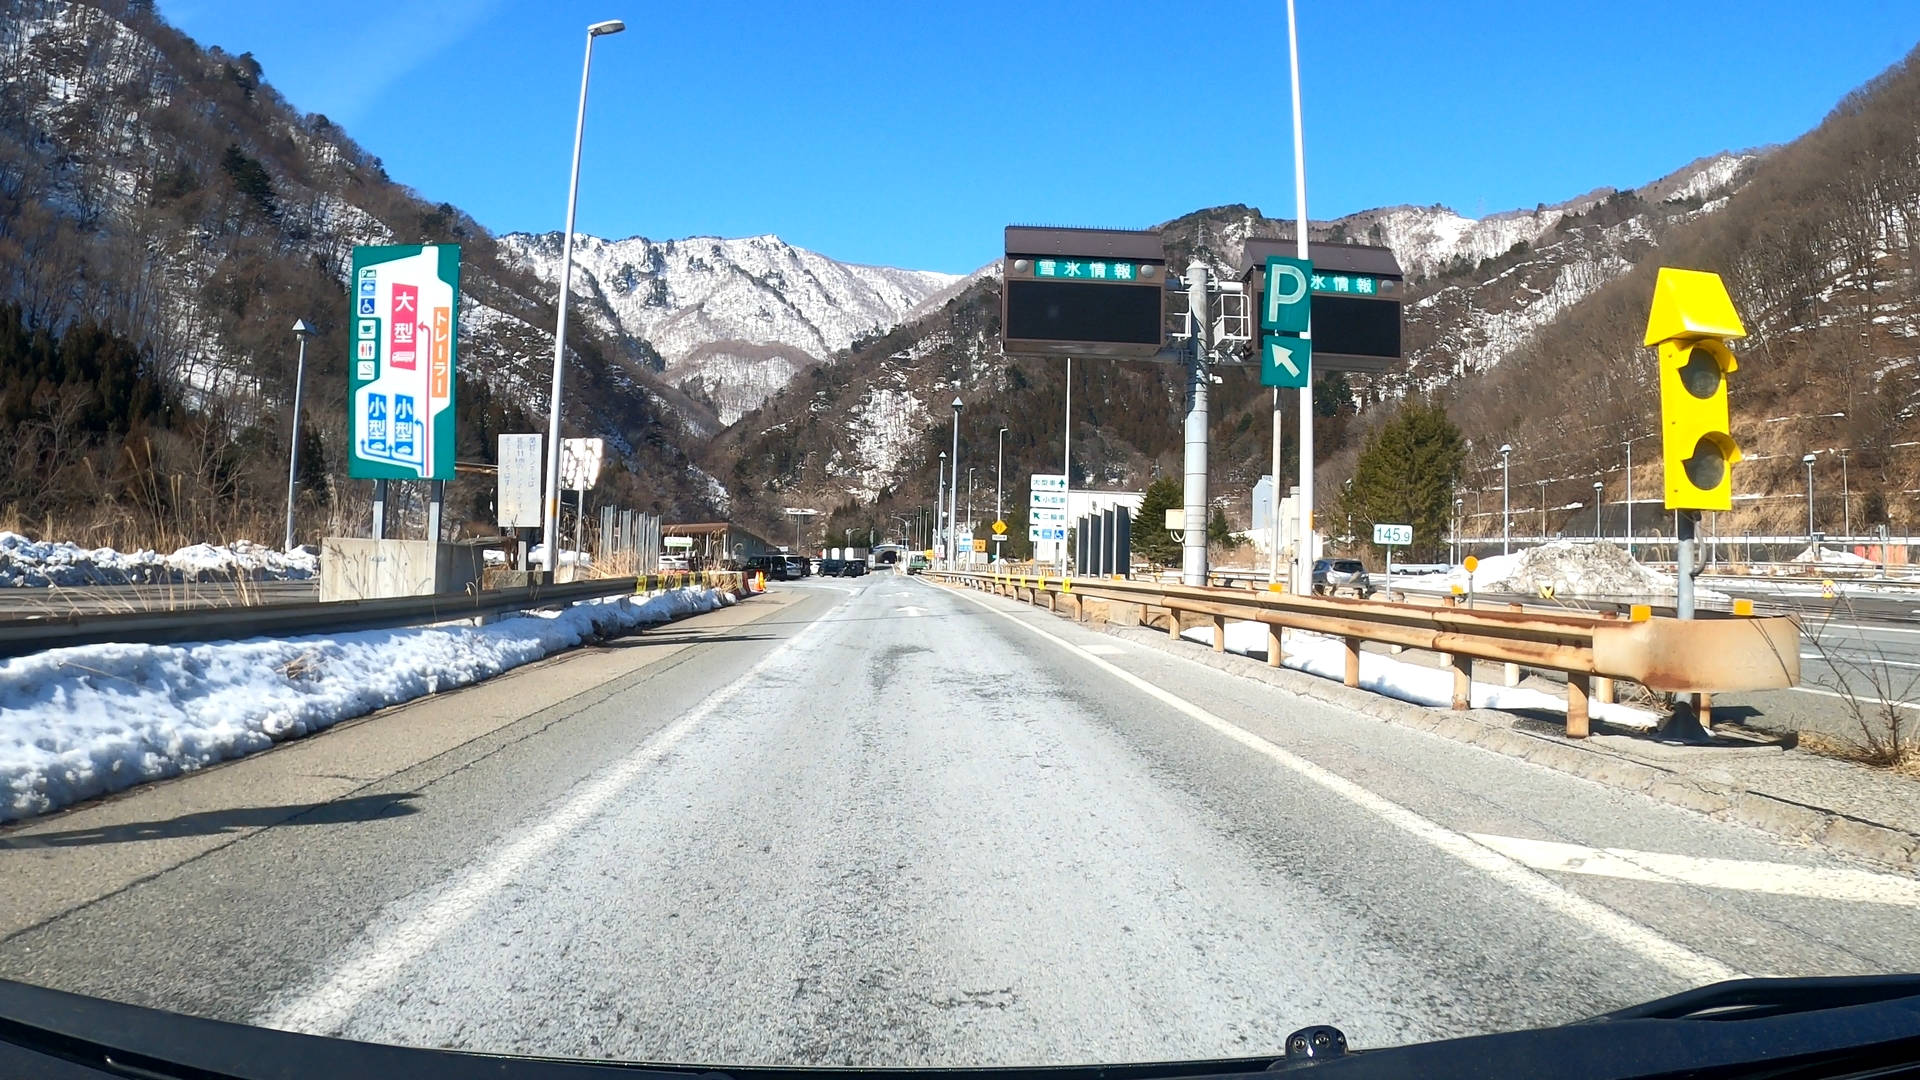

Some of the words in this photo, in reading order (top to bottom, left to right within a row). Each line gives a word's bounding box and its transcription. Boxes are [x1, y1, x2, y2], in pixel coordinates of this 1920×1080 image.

[1039, 260, 1132, 280] 雪氷情報
[1268, 263, 1307, 323] P
[394, 291, 414, 344] 大型
[433, 311, 449, 394] トレーラー
[368, 396, 387, 440] 小型
[395, 397, 414, 442] 小型
[1042, 496, 1066, 504] 小型車
[1376, 527, 1411, 542] 145.9
